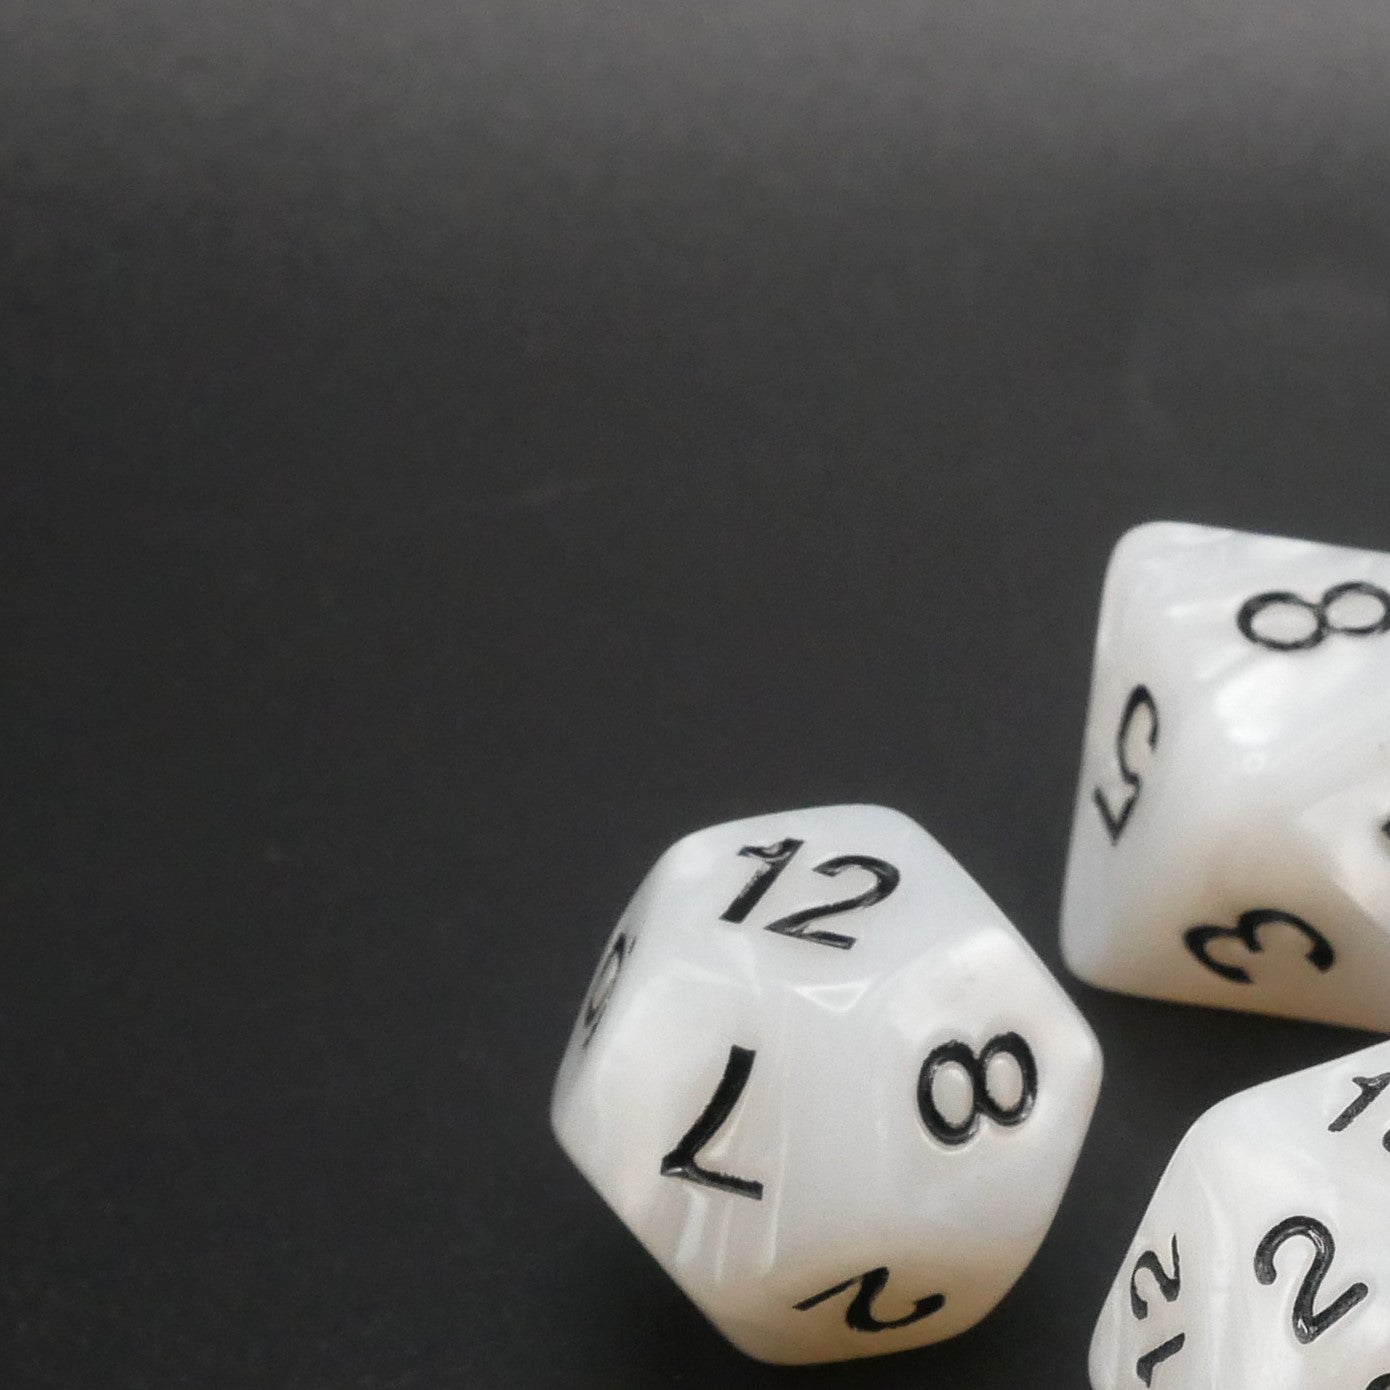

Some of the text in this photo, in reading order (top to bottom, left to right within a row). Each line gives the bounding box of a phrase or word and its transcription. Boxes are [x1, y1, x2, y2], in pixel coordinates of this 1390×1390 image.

[719, 837, 901, 950] 12
[1183, 908, 1337, 985] 3
[660, 1045, 765, 1201] 7
[916, 1031, 1038, 1147] 8
[792, 1266, 946, 1333] 2
[1130, 1232, 1186, 1389] 12
[1253, 1215, 1370, 1345] 2
